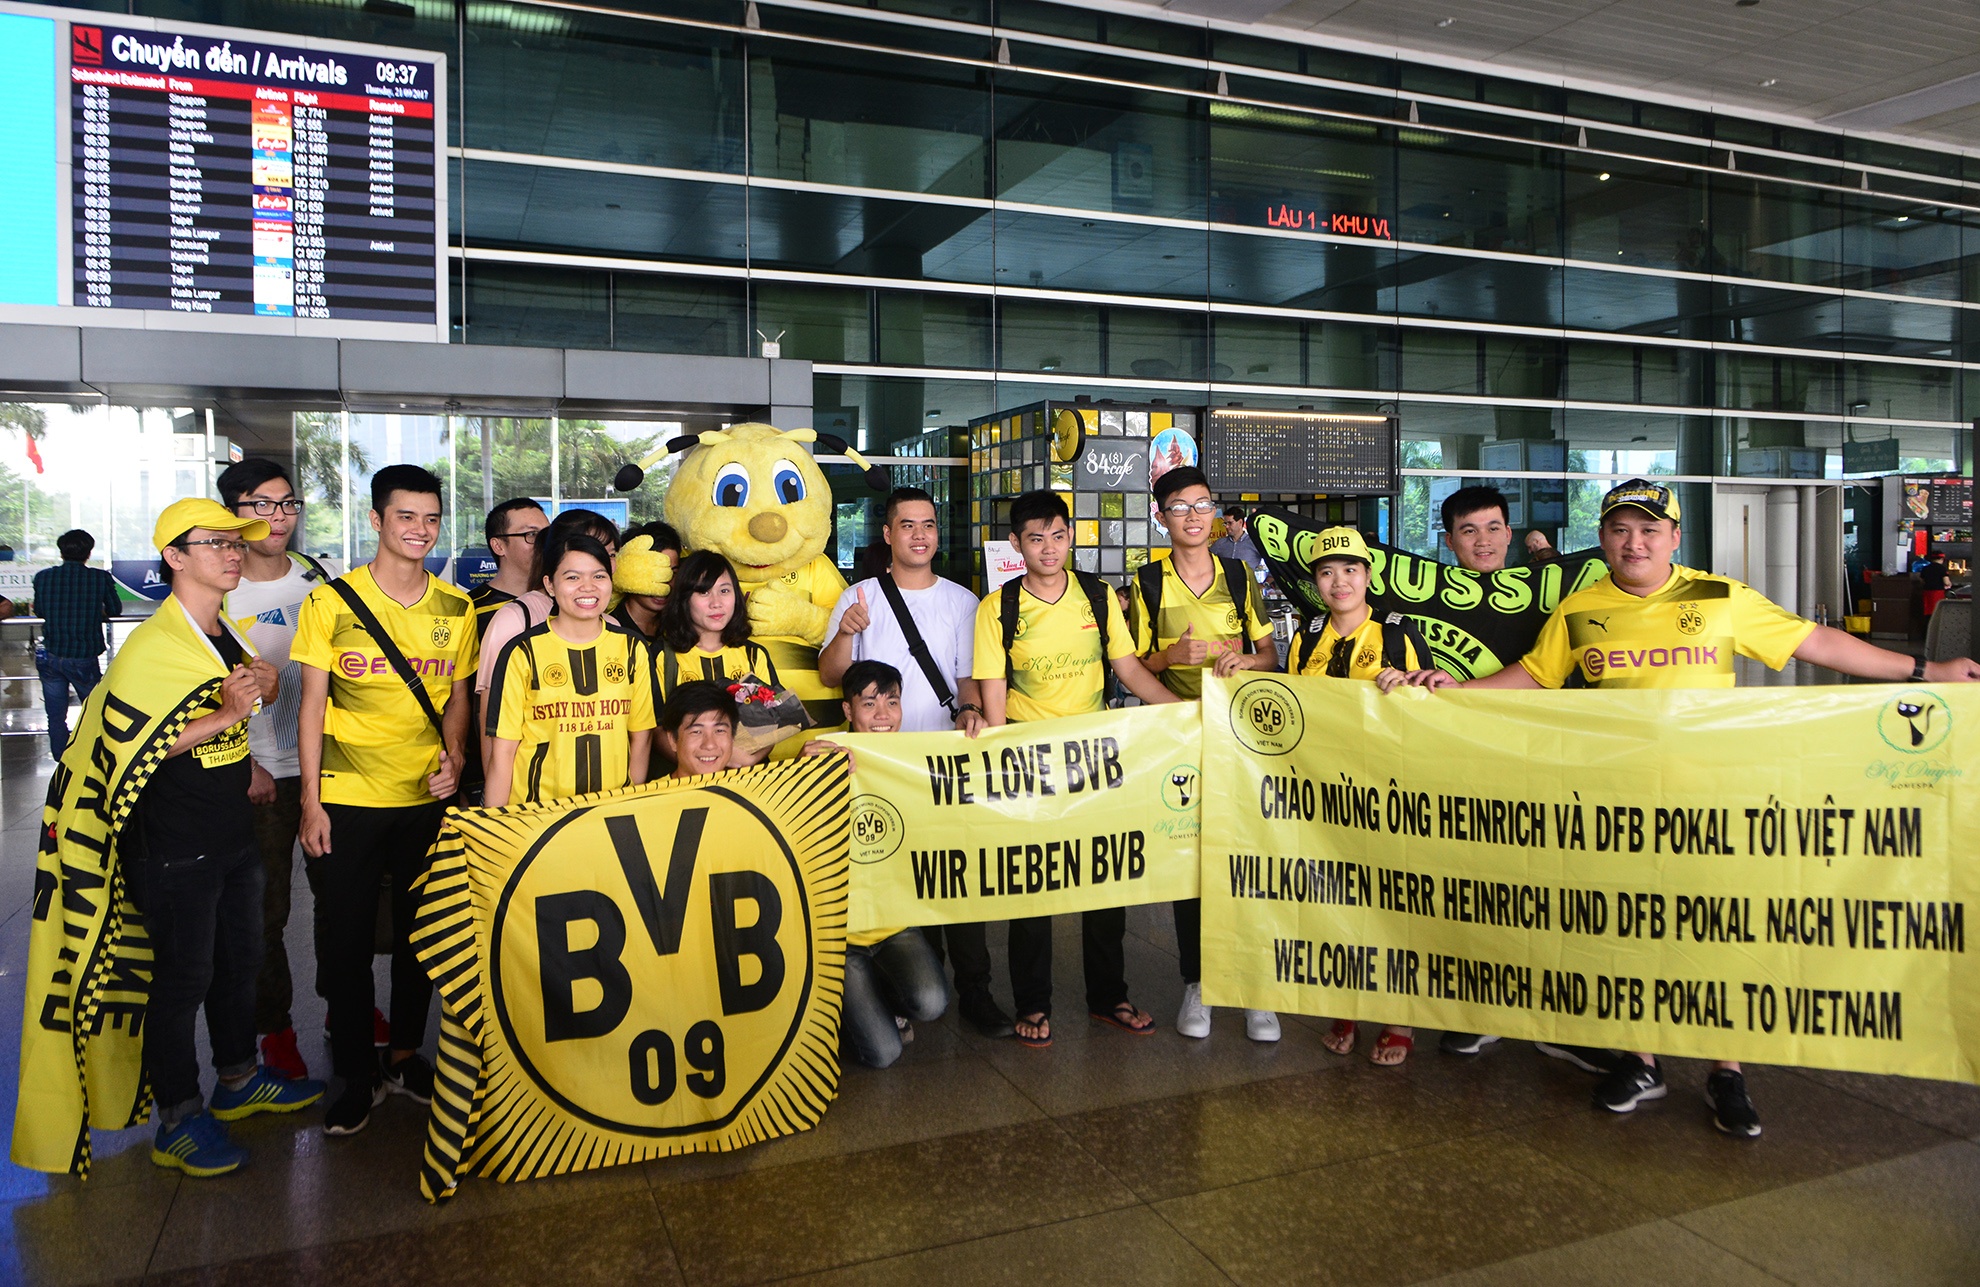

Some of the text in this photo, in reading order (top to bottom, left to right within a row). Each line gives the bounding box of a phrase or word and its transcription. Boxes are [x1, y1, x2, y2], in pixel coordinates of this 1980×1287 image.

[111, 34, 348, 86] Chuyến đến / Arrivals
[376, 62, 418, 85] 09:37
[71, 67, 405, 114] Scheduled Estimated From Airlines Flight Remarks
[294, 130, 307, 140] TR
[294, 142, 307, 154] AK
[294, 153, 307, 164] VN
[295, 188, 308, 200] TG
[1308, 211, 1315, 230] 1
[1332, 214, 1368, 234] KHU
[192, 228, 220, 240] Lumpur
[296, 260, 308, 271] VN
[194, 288, 221, 301] Lumpur
[171, 300, 192, 312] Hong
[192, 300, 212, 313] Kong
[296, 307, 309, 317] VN
[1681, 613, 1703, 629] BVB
[434, 628, 450, 641] BVB
[1608, 646, 1718, 668] EVONIK
[606, 664, 624, 678] BVB
[1042, 671, 1084, 681] HOMESPA
[532, 702, 568, 720] ISTAY
[572, 701, 596, 718] INN
[1254, 700, 1282, 726] BVB
[559, 720, 614, 732] 118 Lê Lai
[1263, 724, 1273, 732] 09
[926, 736, 1124, 806] WE LOVE BVB
[857, 813, 884, 837] BVB
[1260, 765, 1923, 868] CHÀO MỪNG ÔNG HEINRICH VÀ DFB POKAL TỚI VIỆT NAM
[866, 834, 876, 842] 09
[911, 830, 1146, 900] WIR LIEBEN BVB
[1228, 854, 1964, 954] WILLKOMMEN HERR HEINRICH UND DFB POKAL NACH VIETNAM
[534, 806, 787, 1043] BVB
[1274, 937, 1902, 1042] WELCOME MR HEINRICH AND DFB POKAL TO VIETNAM
[628, 1020, 727, 1107] 09
